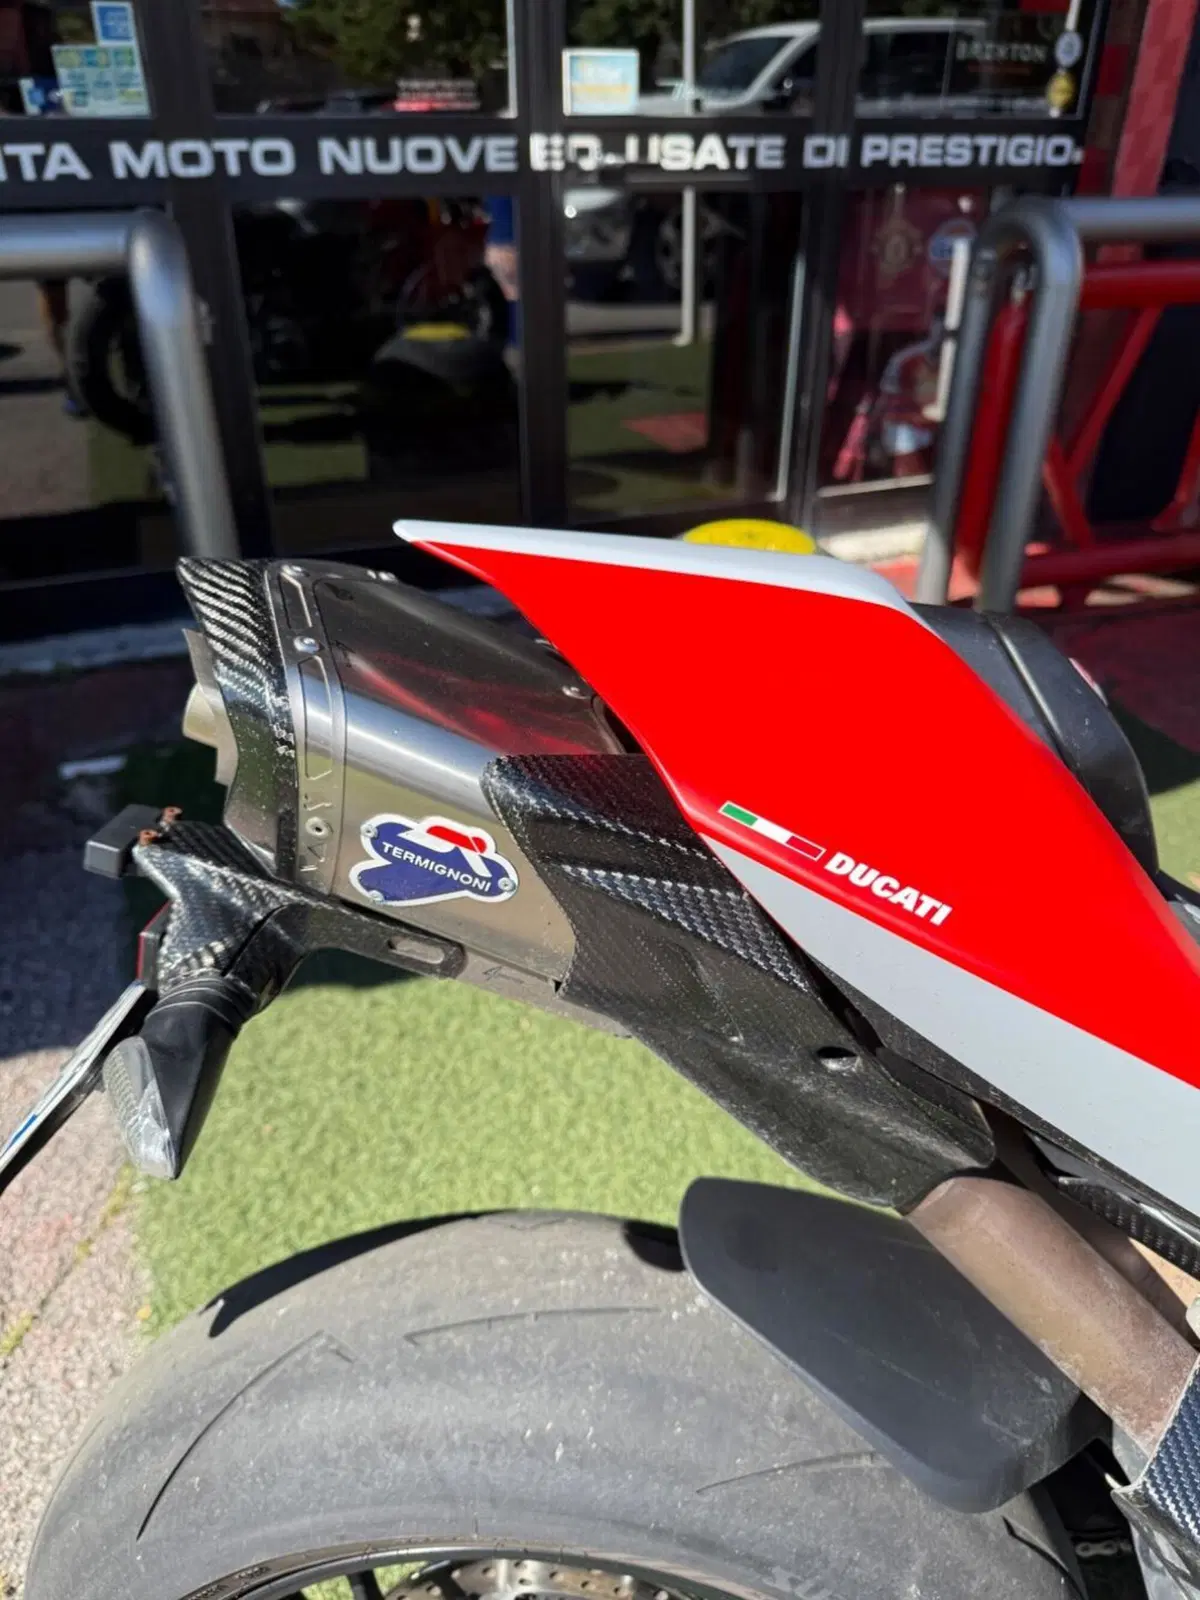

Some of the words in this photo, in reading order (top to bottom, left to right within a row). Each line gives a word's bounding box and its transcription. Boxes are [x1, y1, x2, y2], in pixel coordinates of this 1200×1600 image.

[109, 138, 296, 179] MOTO
[319, 134, 518, 174] NUOVE
[802, 134, 849, 169] DI
[381, 841, 492, 893] TERMIGNONI
[823, 851, 953, 926] DUCATI
